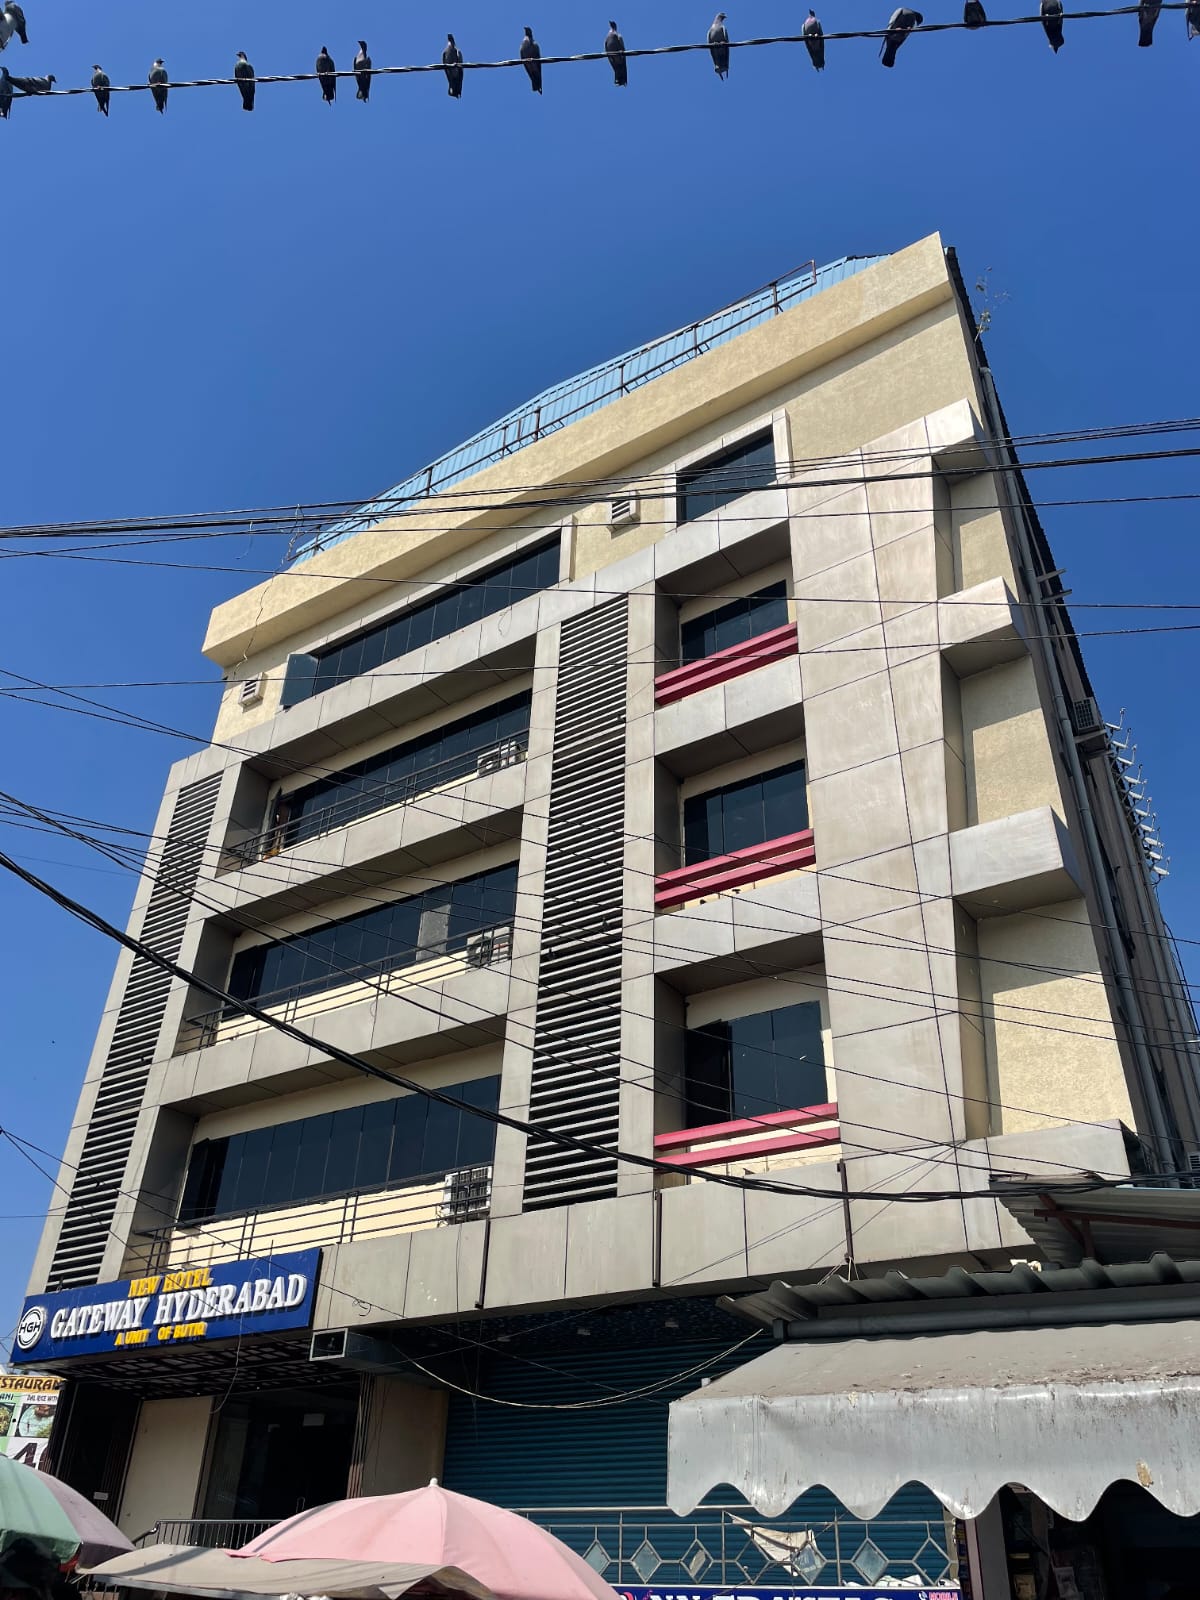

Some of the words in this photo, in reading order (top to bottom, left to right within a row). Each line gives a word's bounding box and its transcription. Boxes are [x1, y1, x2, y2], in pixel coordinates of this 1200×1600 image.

[128, 1276, 164, 1298] NEW
[162, 1267, 214, 1292] HOTEL
[50, 1297, 150, 1339] GATEWAY
[153, 1274, 307, 1326] HYDERABAD
[19, 1320, 41, 1334] HGH
[114, 1332, 125, 1346] A
[124, 1329, 151, 1345] UNIT
[158, 1326, 173, 1341] OF
